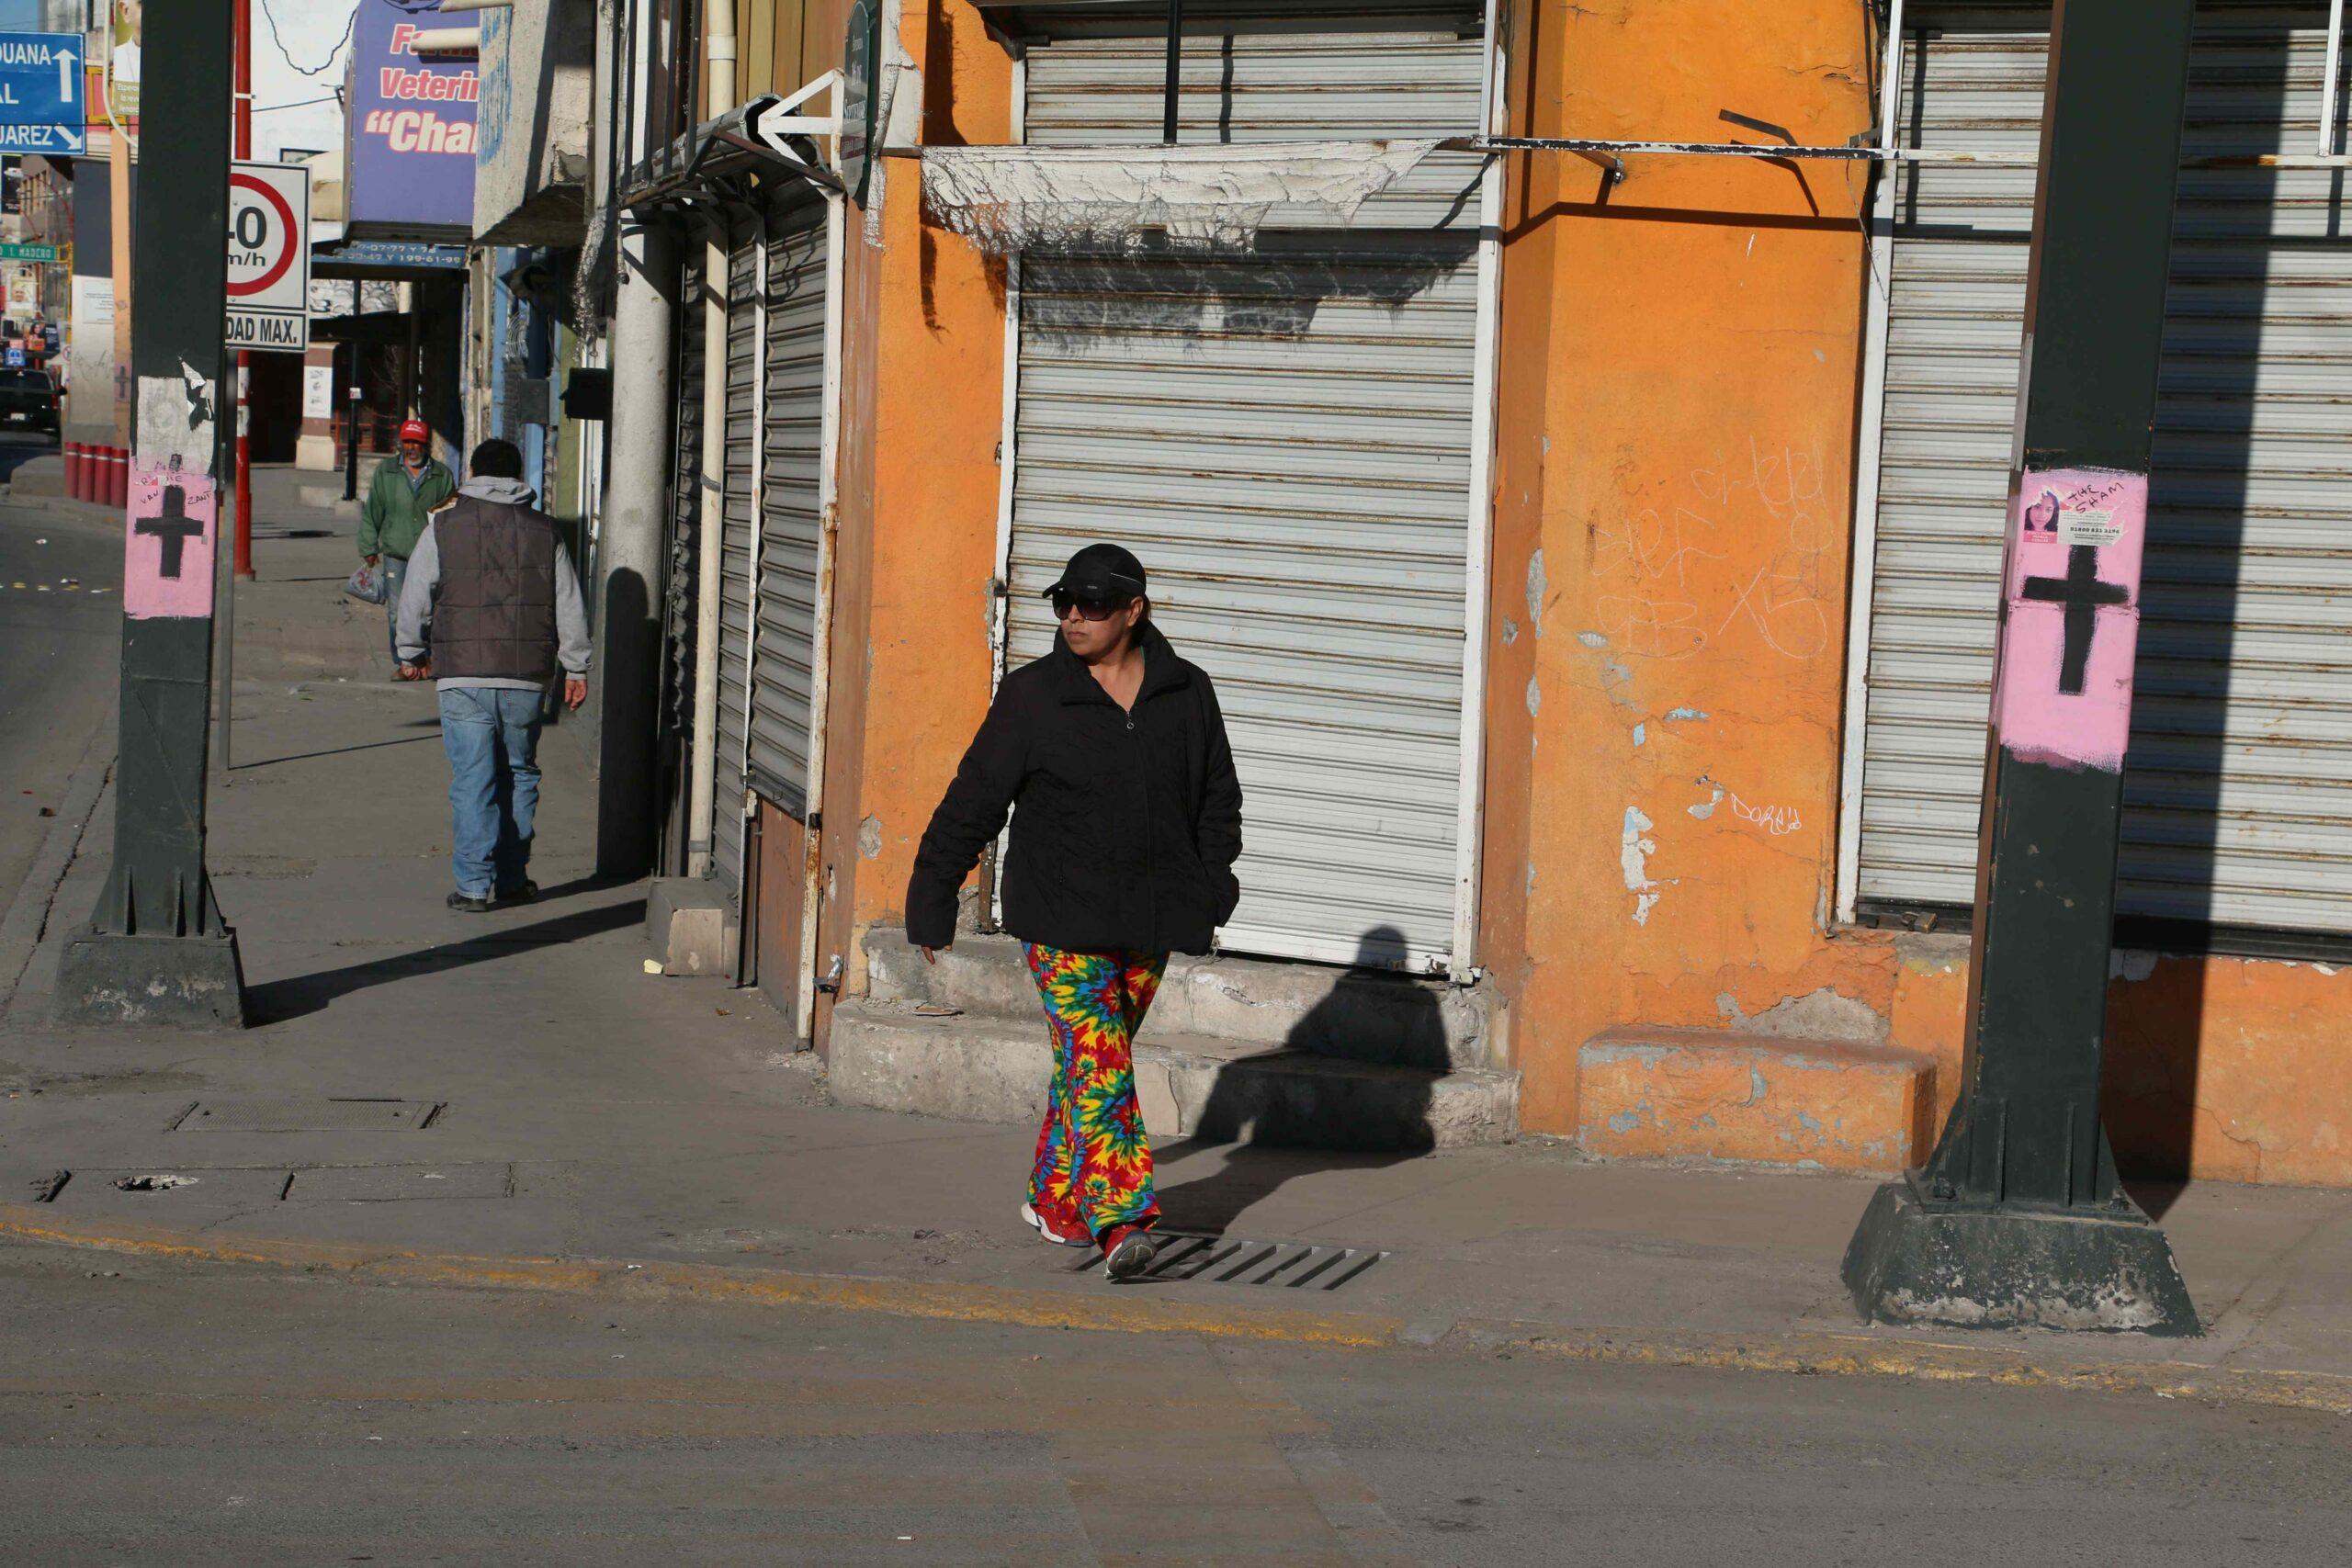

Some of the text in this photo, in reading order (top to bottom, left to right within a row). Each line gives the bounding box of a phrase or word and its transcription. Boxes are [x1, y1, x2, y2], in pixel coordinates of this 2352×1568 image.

[0, 42, 51, 65] UANA
[228, 206, 267, 249] 0
[19, 247, 51, 258] MADERO
[260, 318, 297, 344] MAX.
